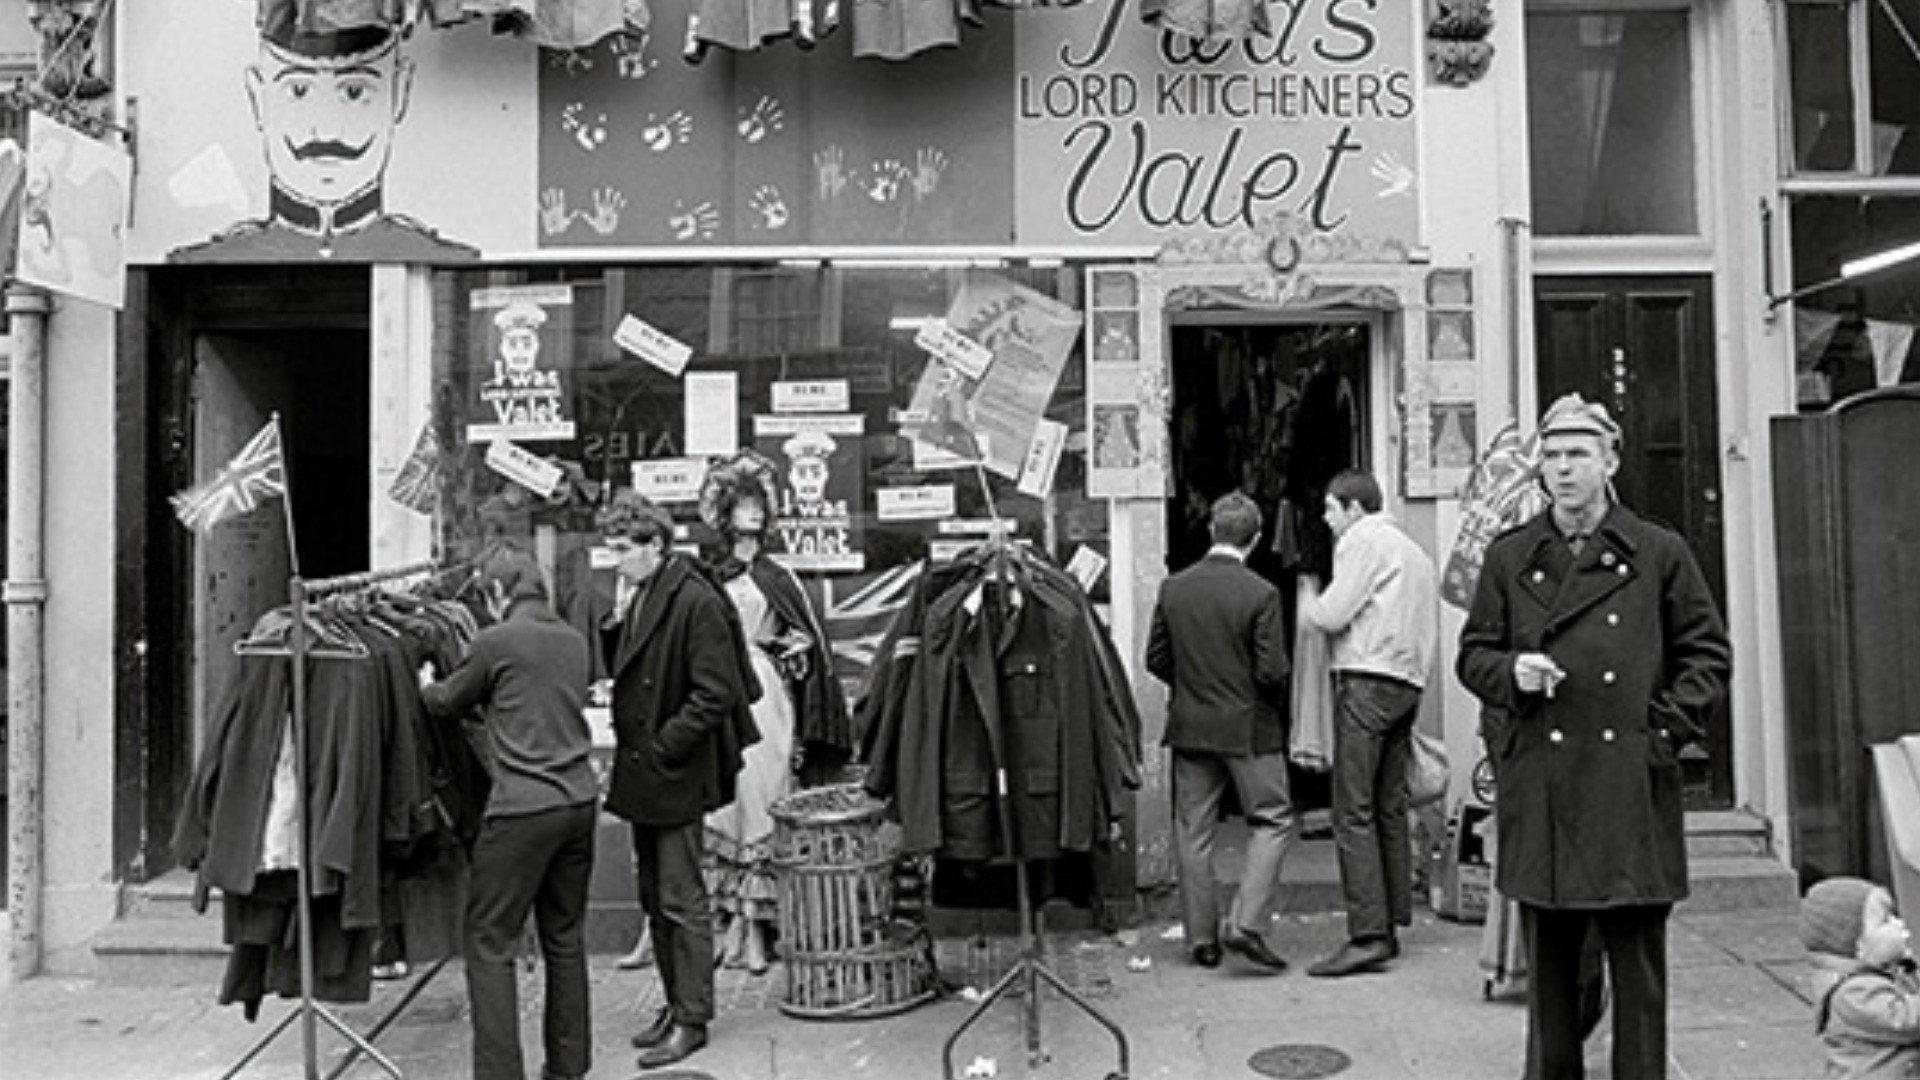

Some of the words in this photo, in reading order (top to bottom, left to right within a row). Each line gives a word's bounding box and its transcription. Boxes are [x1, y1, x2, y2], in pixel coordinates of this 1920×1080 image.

[1020, 75, 1137, 118] LORD
[1063, 121, 1362, 232] Valet
[492, 400, 564, 424] Valet
[780, 528, 850, 554] Valet
